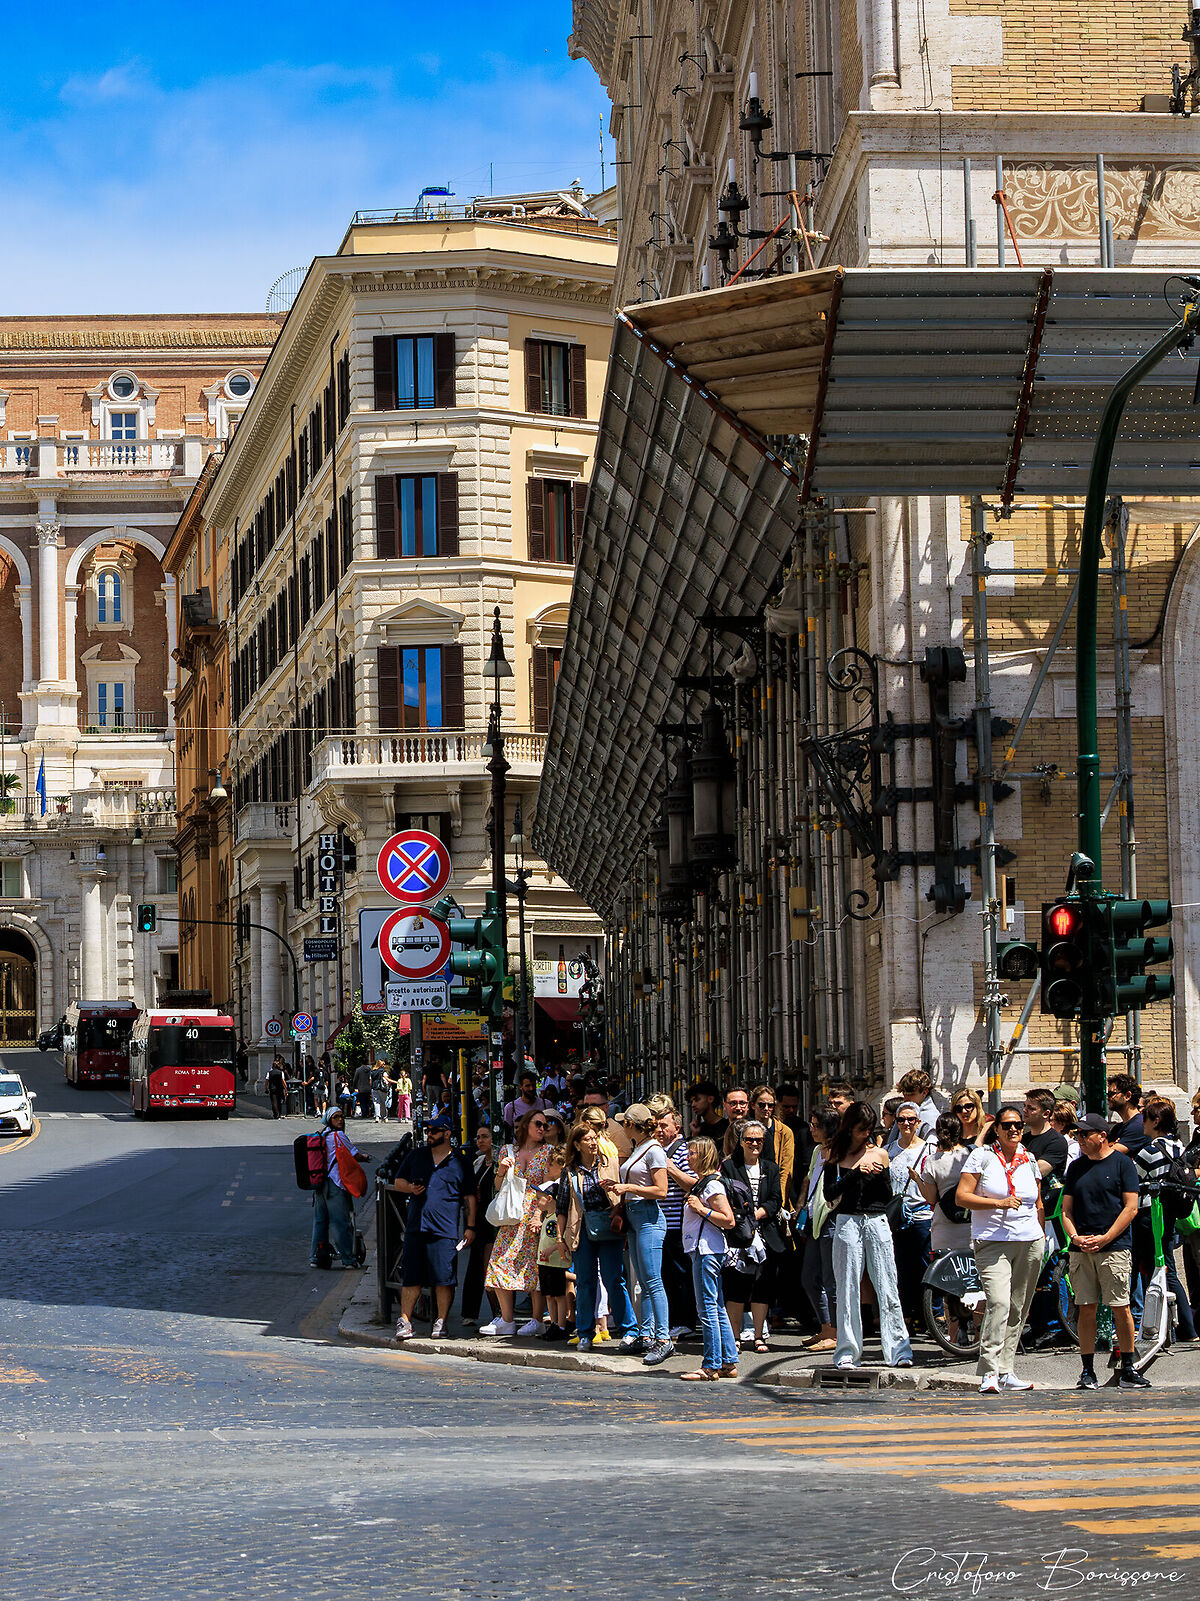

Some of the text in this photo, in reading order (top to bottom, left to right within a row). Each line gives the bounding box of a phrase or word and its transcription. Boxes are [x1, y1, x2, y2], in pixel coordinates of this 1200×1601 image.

[320, 834, 336, 933] HOTEL
[412, 986, 445, 994] autorizzati
[410, 998, 431, 1006] ATAC
[106, 1020, 117, 1028] 40
[269, 1024, 280, 1032] 30
[186, 1028, 199, 1038] 40
